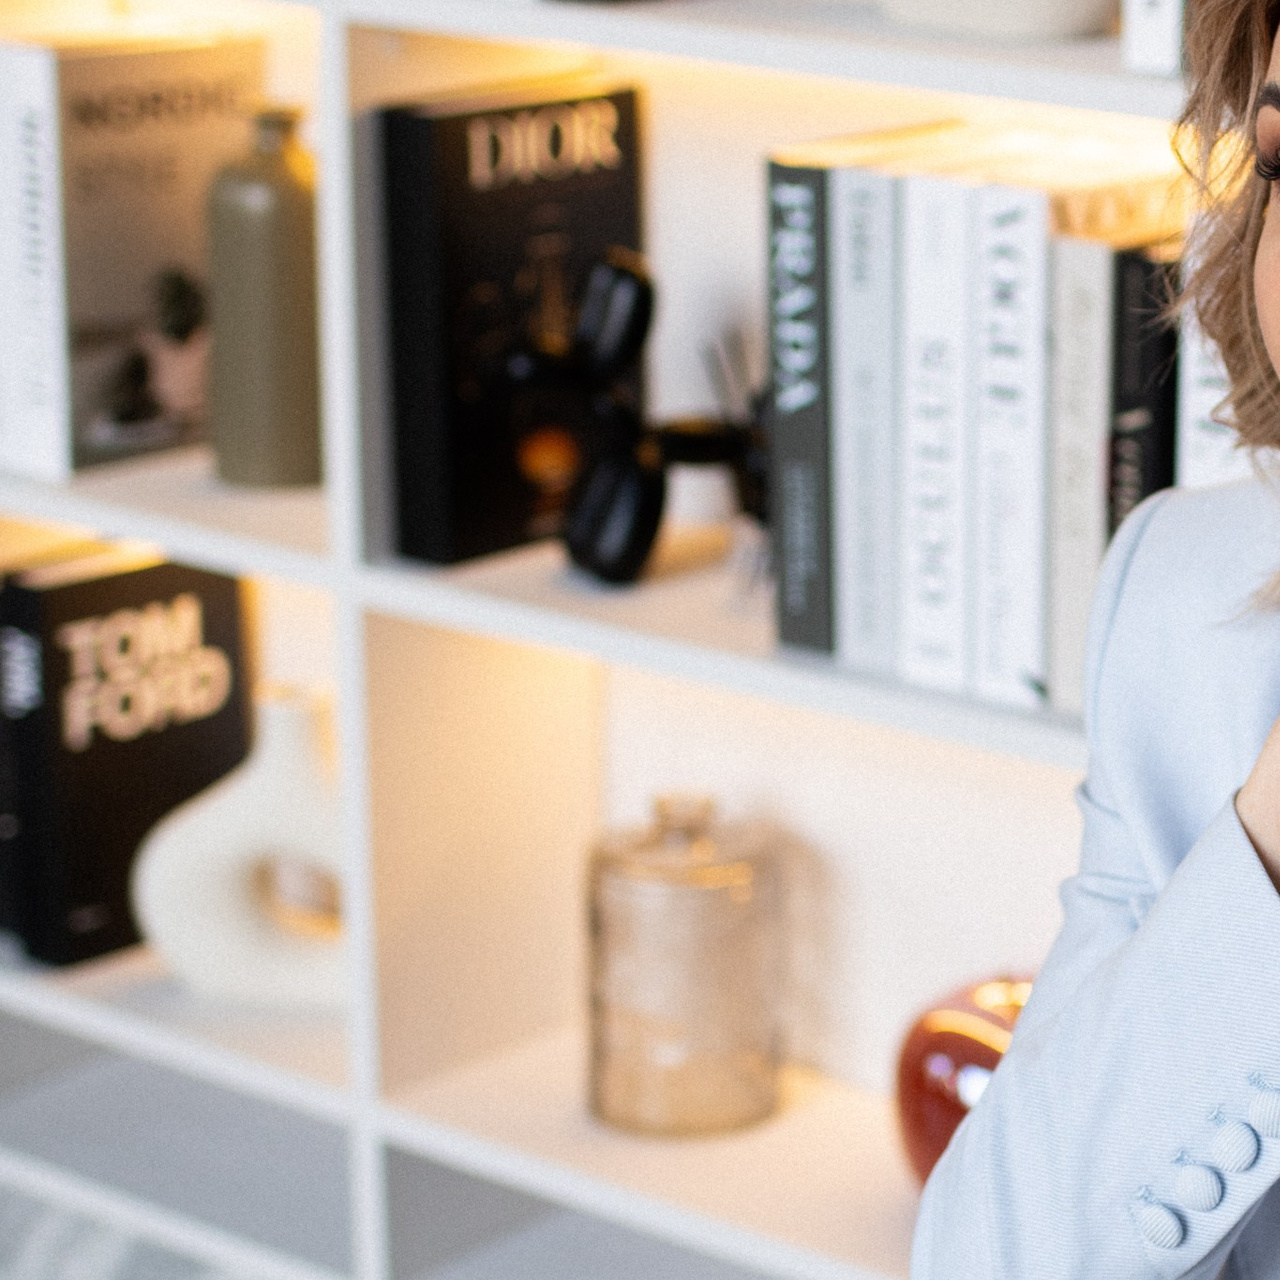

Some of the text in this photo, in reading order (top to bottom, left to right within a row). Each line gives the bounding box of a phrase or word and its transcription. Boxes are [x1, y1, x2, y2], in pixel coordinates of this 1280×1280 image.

[467, 100, 621, 191] DIOR
[773, 182, 819, 413] PRADA
[56, 591, 204, 682] TOM
[61, 646, 232, 754] FORD
